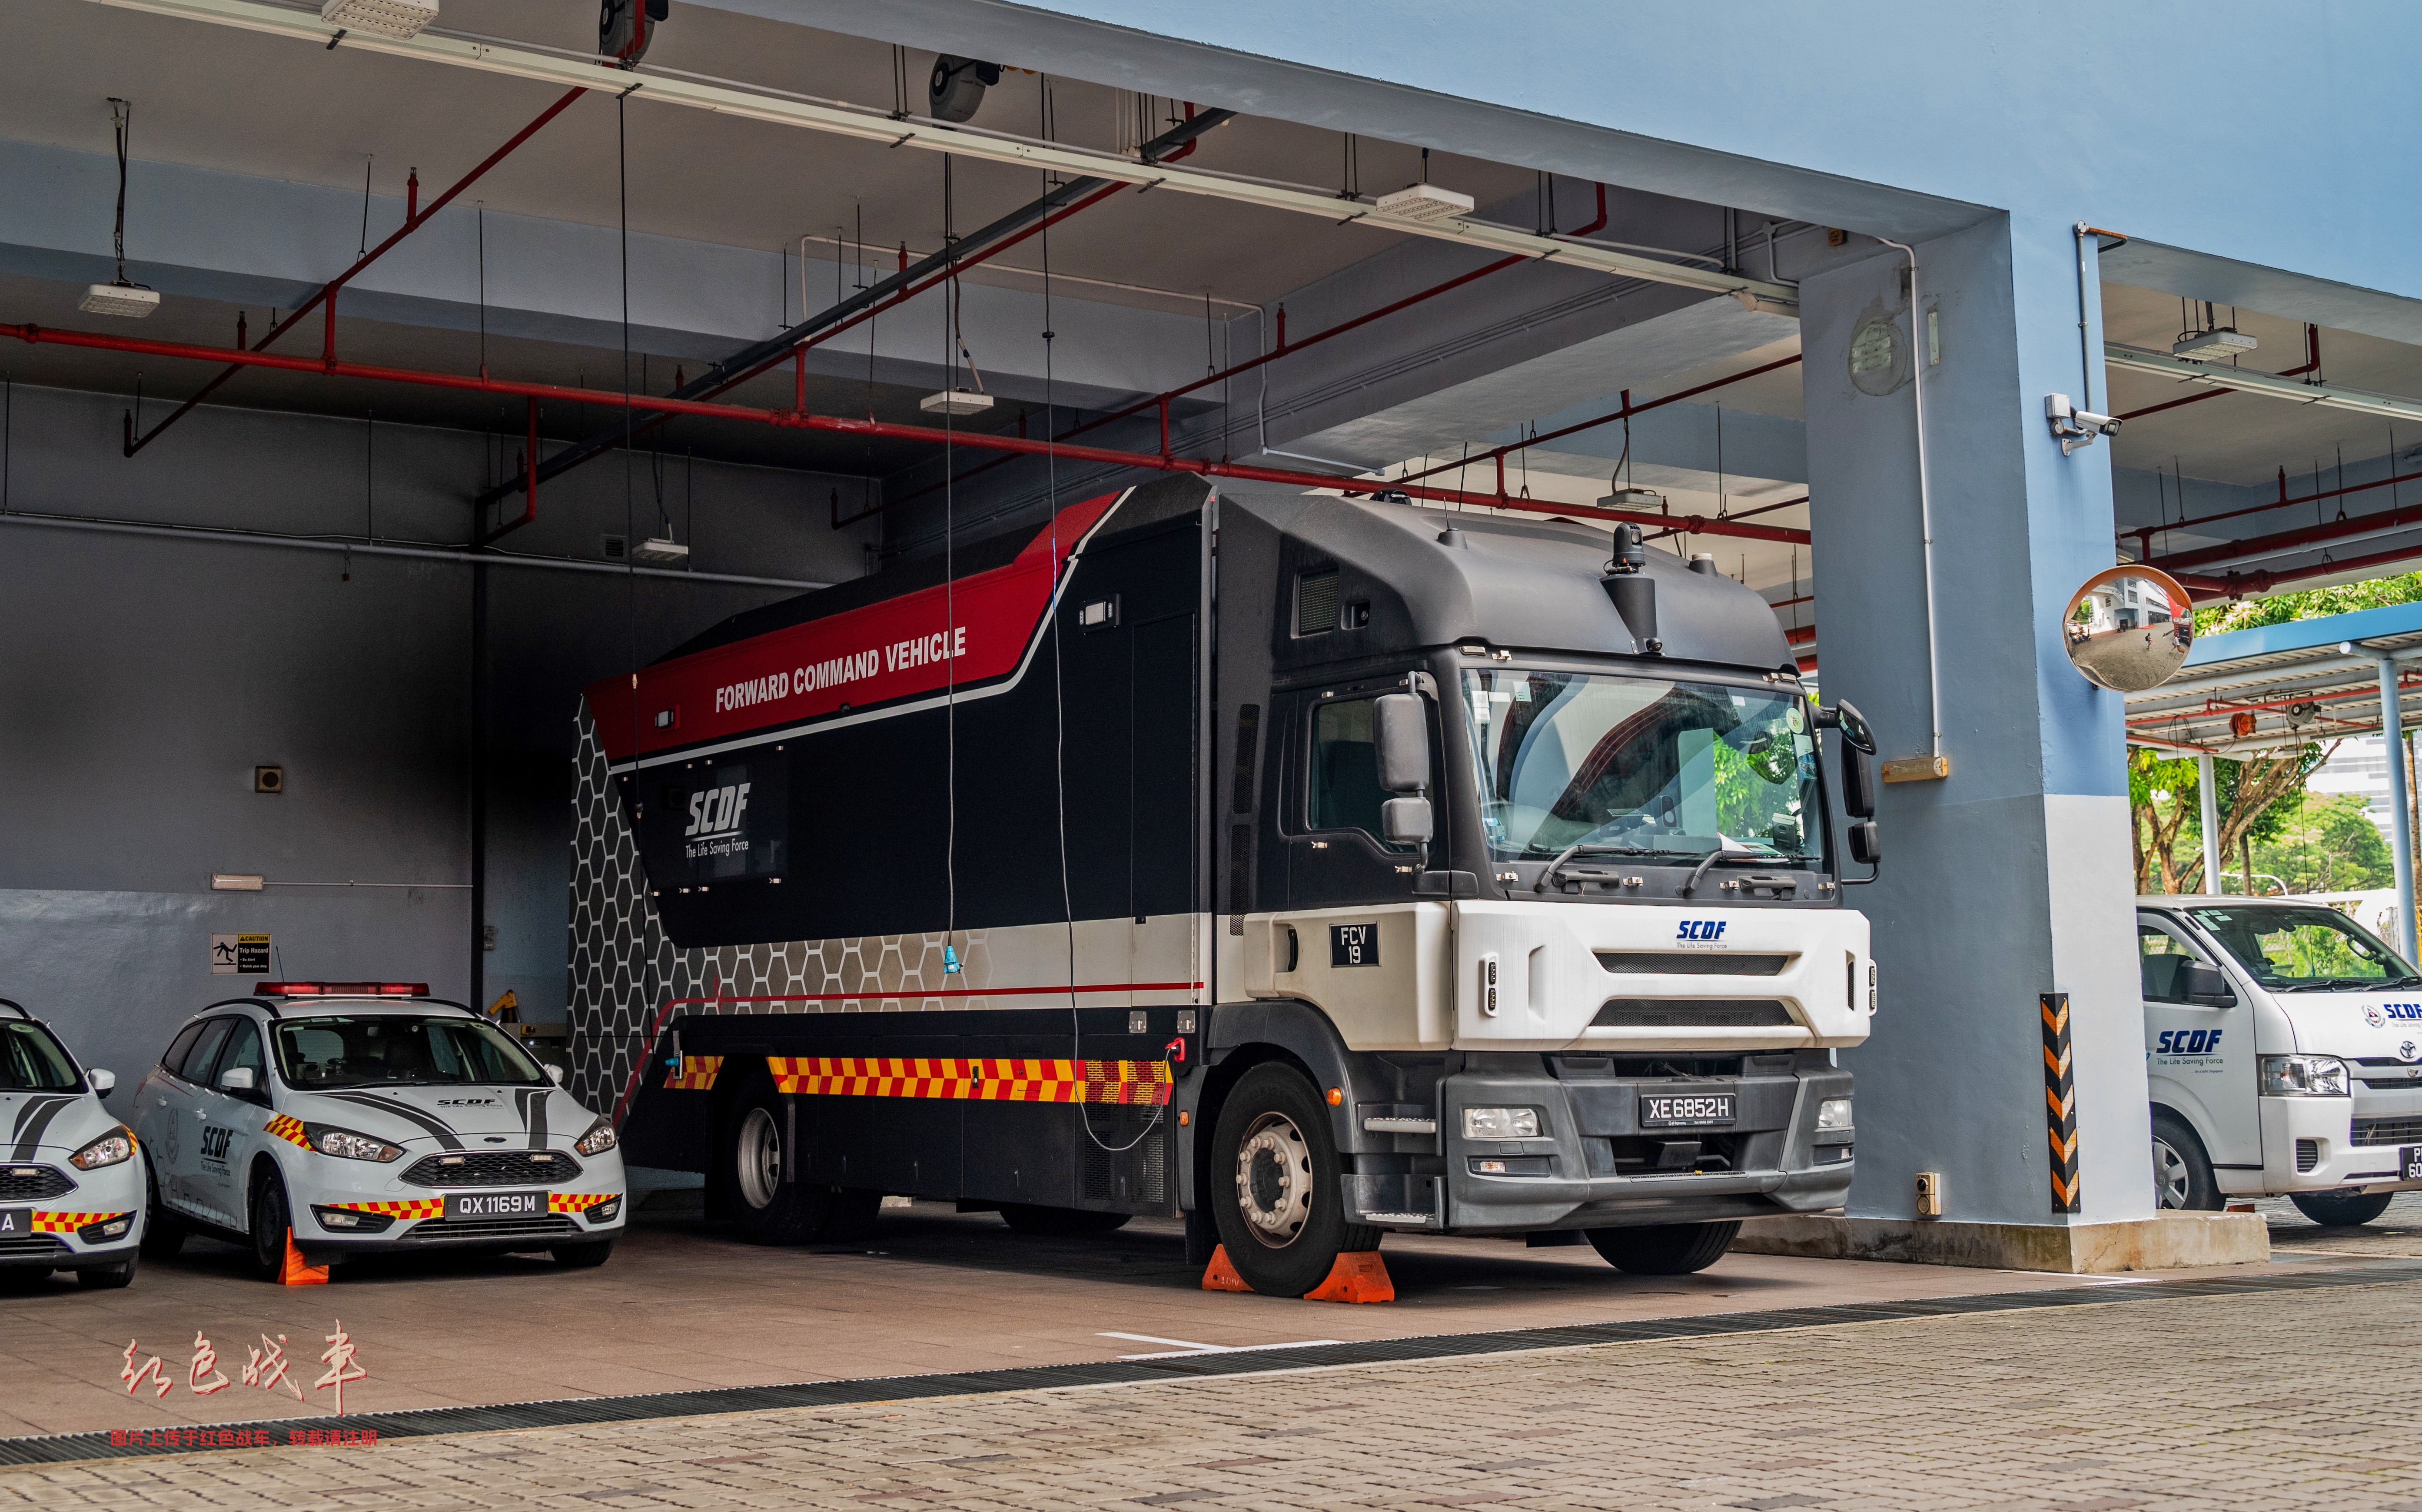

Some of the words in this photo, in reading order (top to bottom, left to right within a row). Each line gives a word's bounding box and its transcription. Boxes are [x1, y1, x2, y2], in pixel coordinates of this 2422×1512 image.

[716, 672, 789, 713] FORWARD
[794, 649, 879, 695] COMMAND
[885, 626, 966, 672] VEHICLE
[685, 782, 751, 836] SCDF
[686, 844, 696, 858] The
[698, 841, 708, 856] Life
[710, 841, 730, 856] Saving
[732, 838, 748, 852] Force
[1341, 926, 1366, 945] FCV
[1676, 920, 1726, 939] SCDF
[1349, 946, 1361, 964] 19
[2383, 1004, 2422, 1018] SCDF
[2156, 1030, 2223, 1053] SCDF
[2182, 1057, 2203, 1066] Saving
[1649, 1098, 1729, 1118] XE6852H
[201, 1126, 233, 1159] SCDF
[2413, 1147, 2422, 1162] P
[460, 1196, 535, 1214] QX1169M
